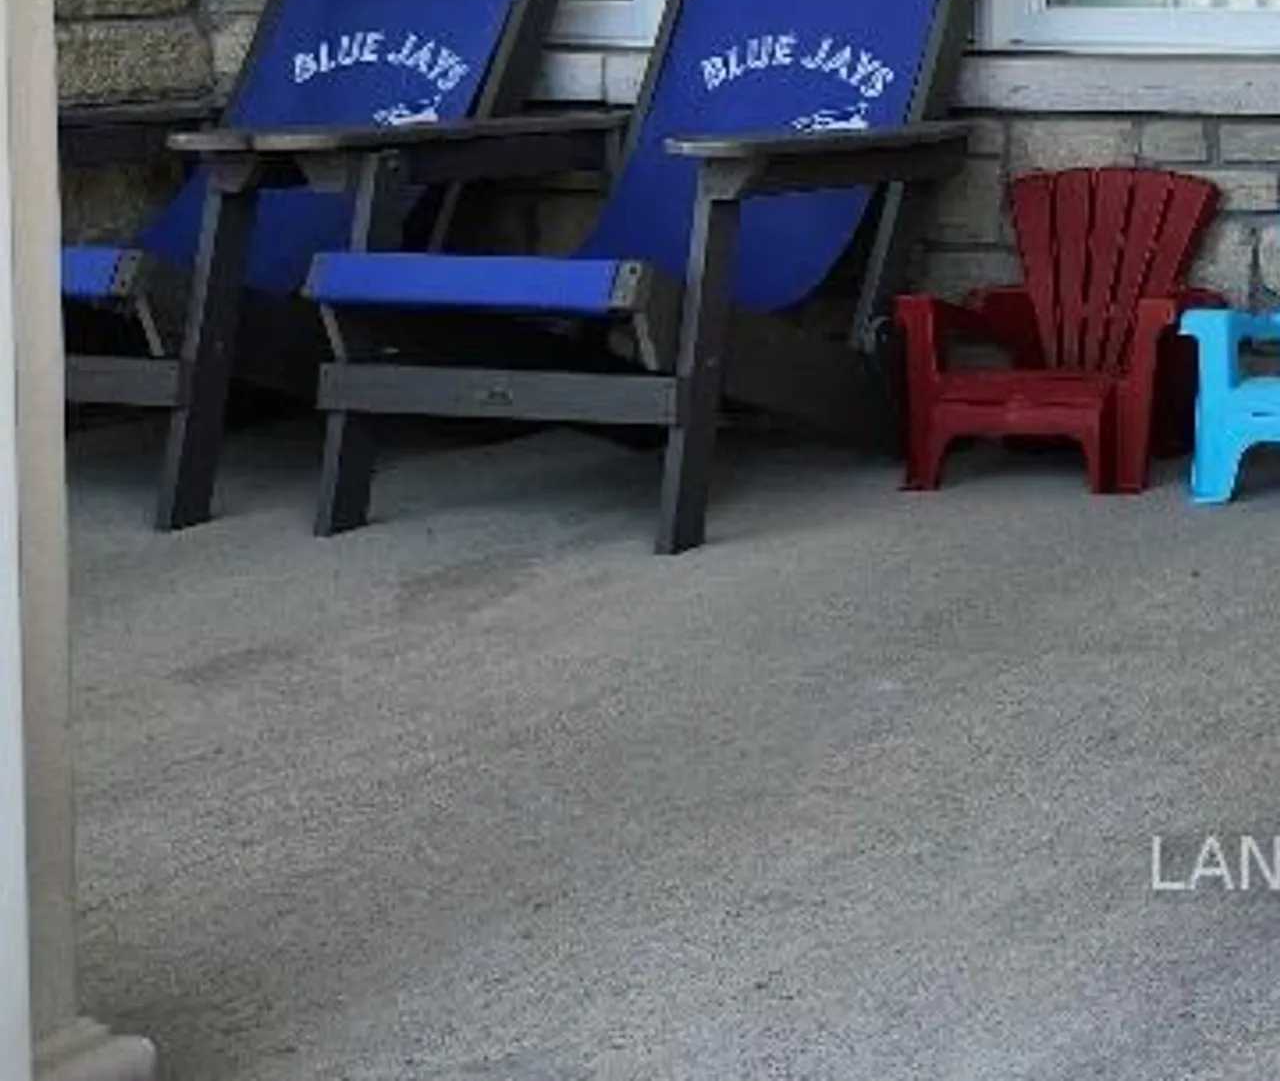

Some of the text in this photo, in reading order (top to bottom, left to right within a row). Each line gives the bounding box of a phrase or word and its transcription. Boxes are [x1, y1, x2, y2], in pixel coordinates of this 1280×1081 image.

[294, 31, 467, 91] BLUE JAYS
[700, 34, 894, 97] BLUE JAYS
